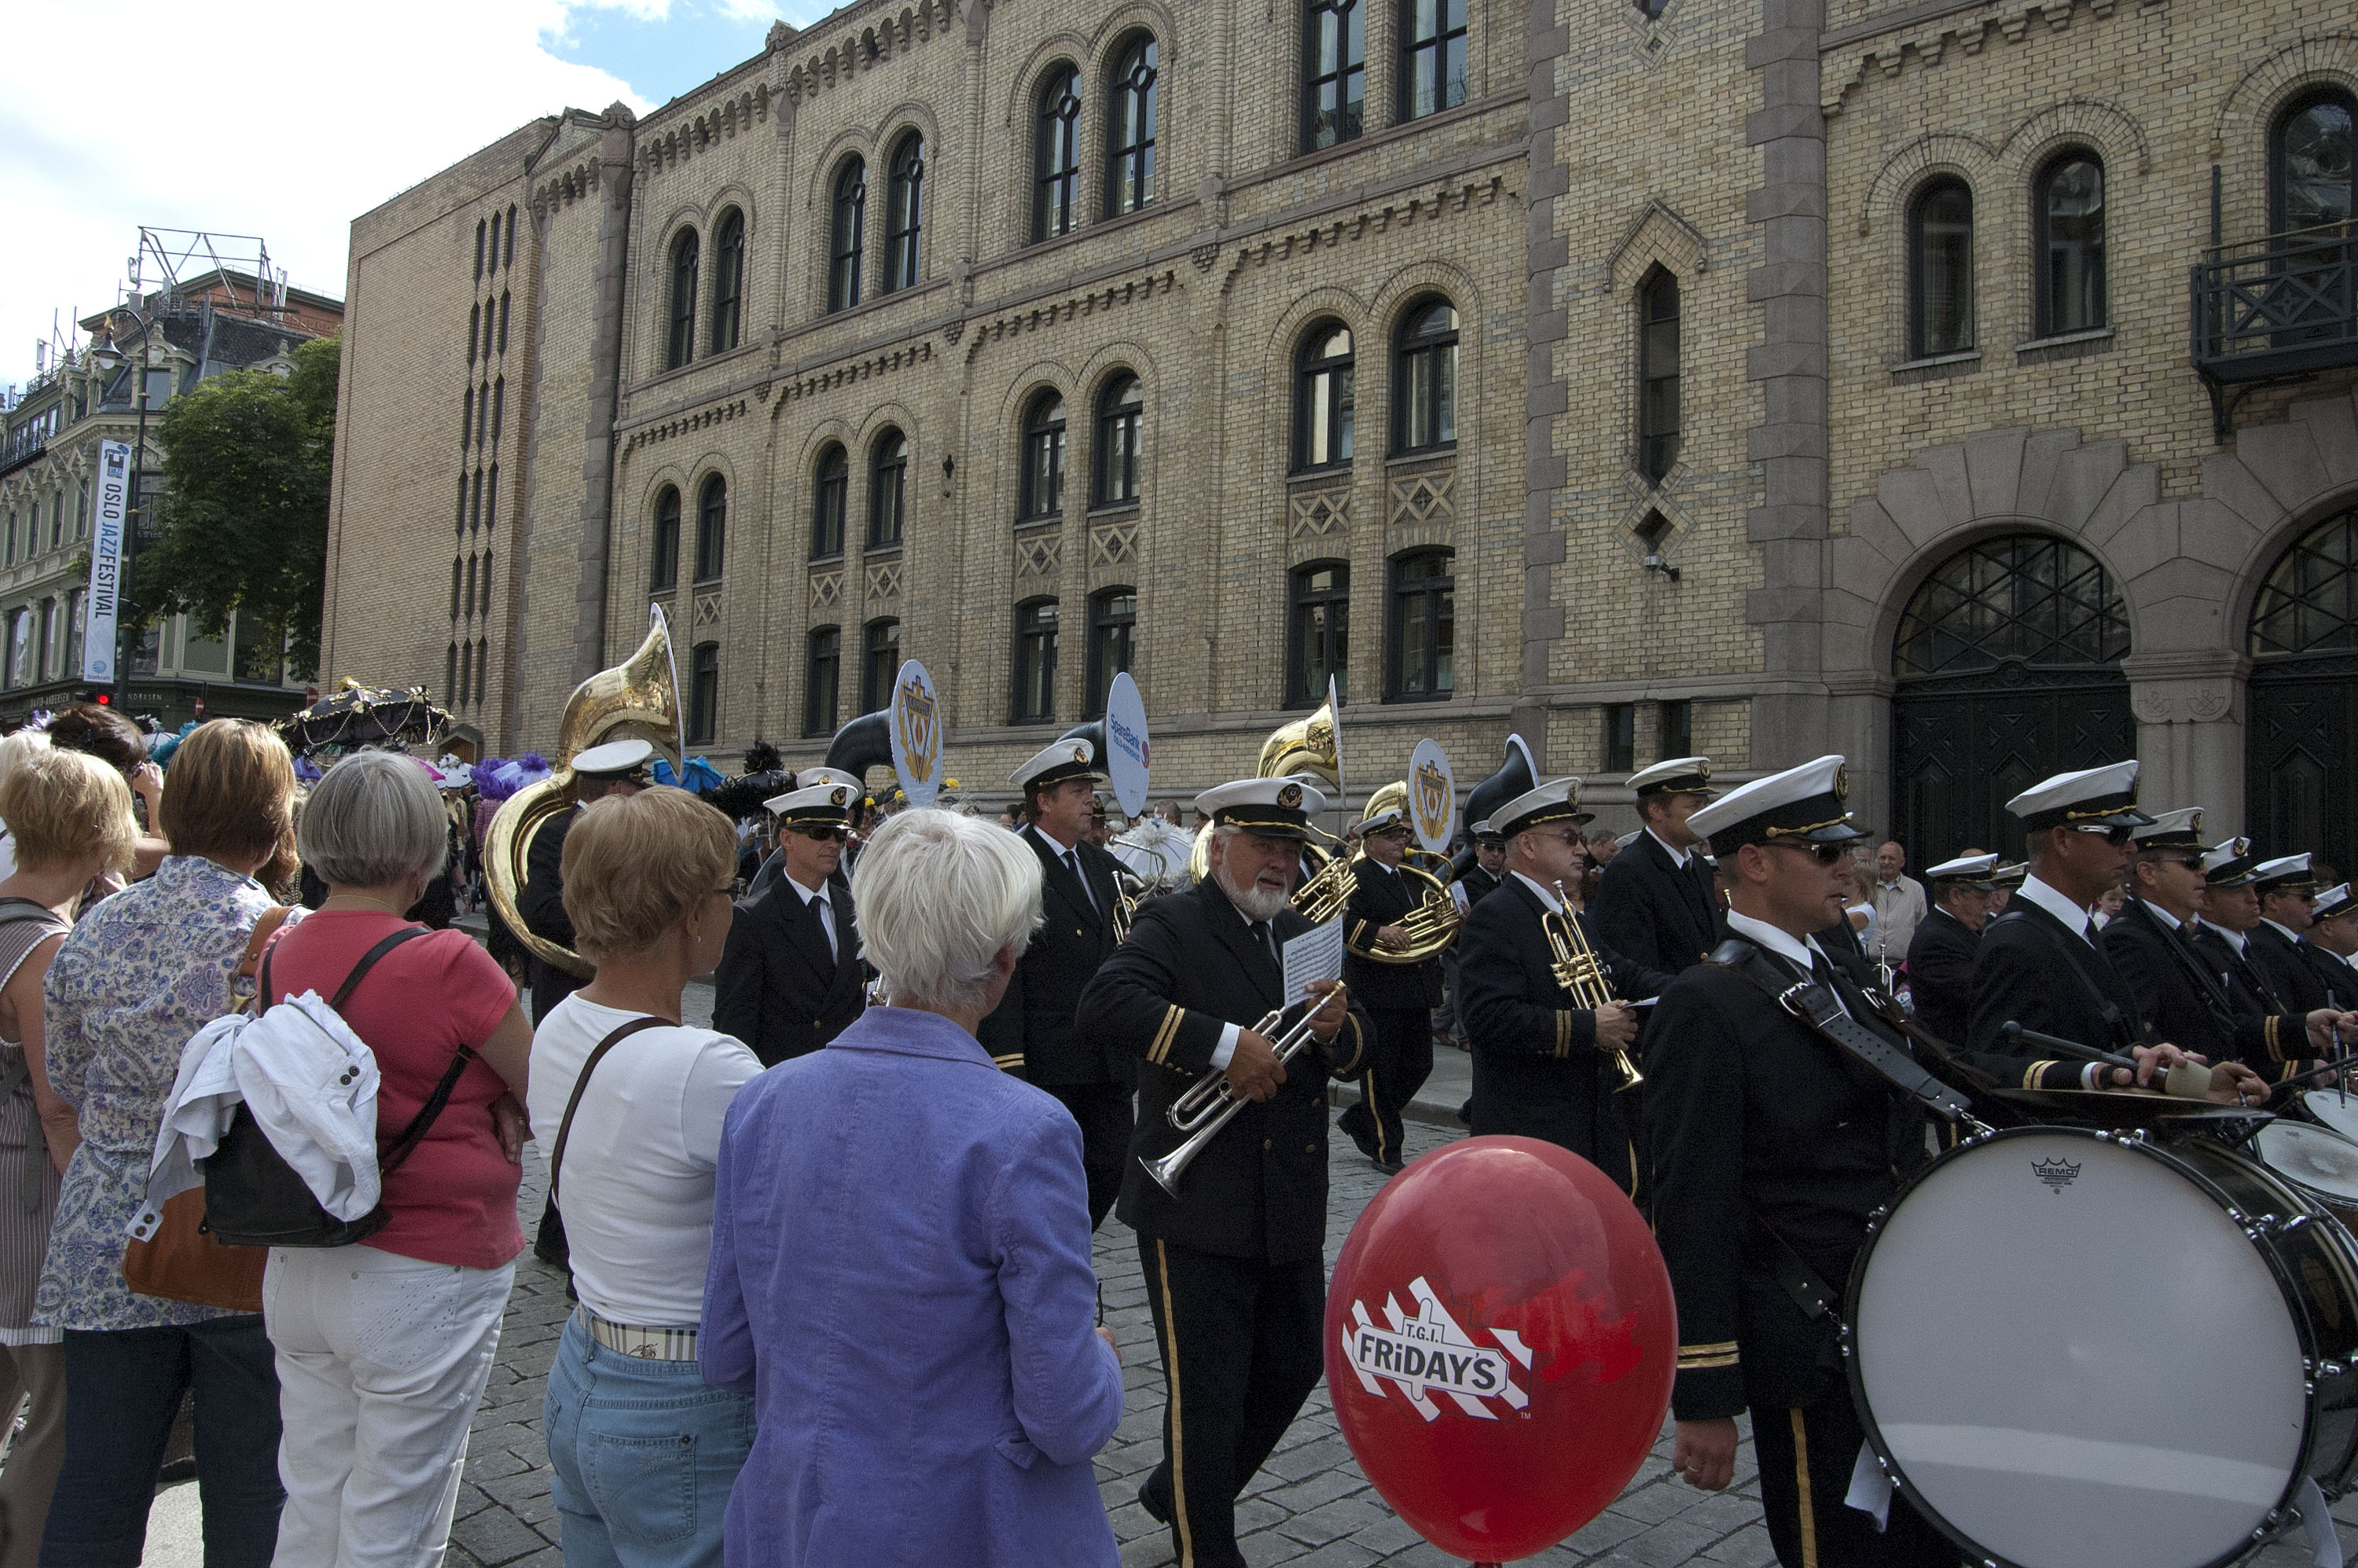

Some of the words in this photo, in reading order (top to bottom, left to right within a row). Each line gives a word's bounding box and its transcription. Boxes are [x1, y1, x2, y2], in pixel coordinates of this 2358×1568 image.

[104, 483, 122, 519] OSLO
[95, 521, 118, 619] JAZZFESTIVAL
[1111, 714, 1140, 751] SpareBank
[1406, 1324, 1438, 1343] T.G.I.
